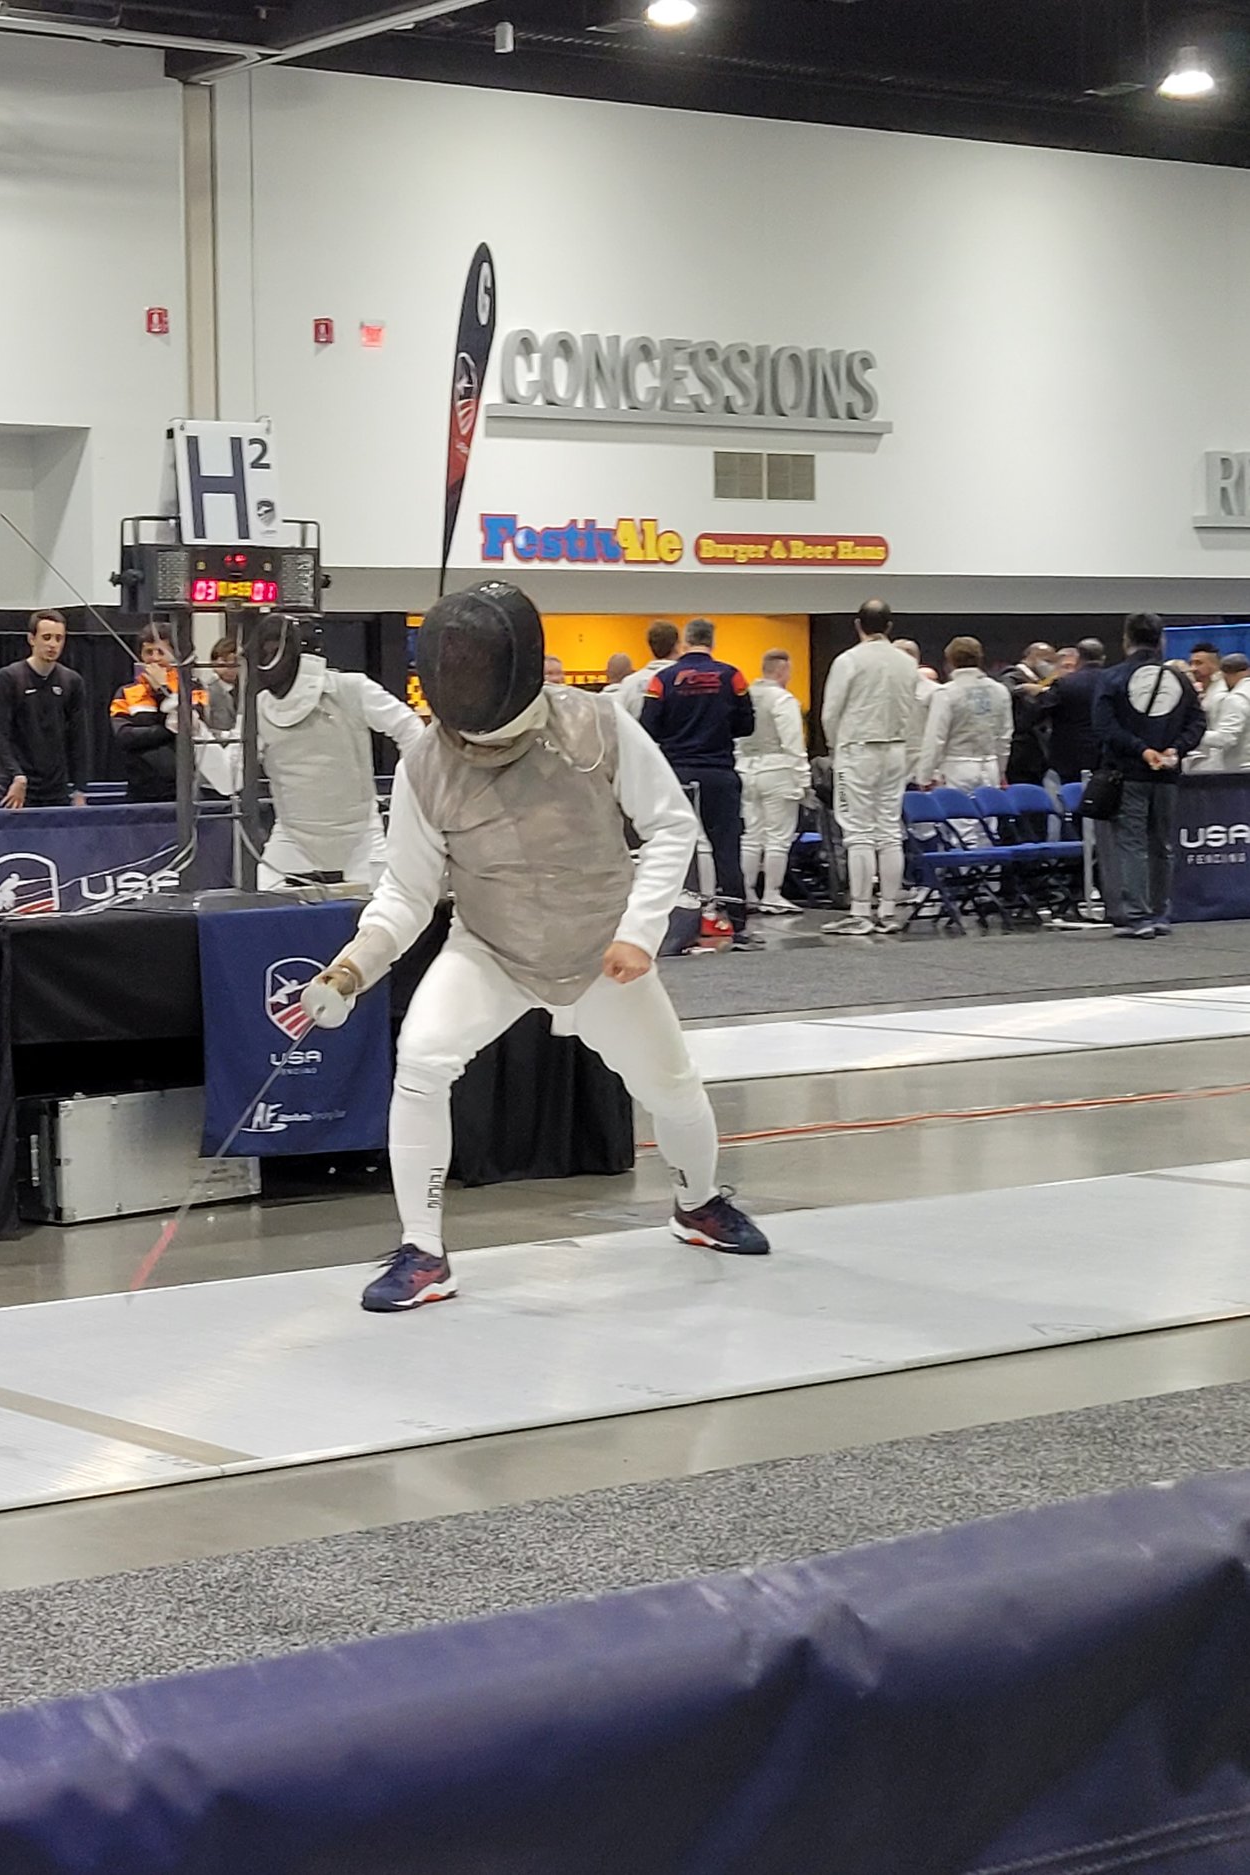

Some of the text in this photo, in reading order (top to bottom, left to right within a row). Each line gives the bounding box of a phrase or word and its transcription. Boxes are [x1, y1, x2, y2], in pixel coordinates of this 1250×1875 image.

[501, 329, 878, 420] CONCESSIONS
[699, 539, 768, 563] Burger
[789, 540, 836, 559] Beer
[1180, 824, 1250, 848] USA
[270, 1050, 323, 1066] USA
